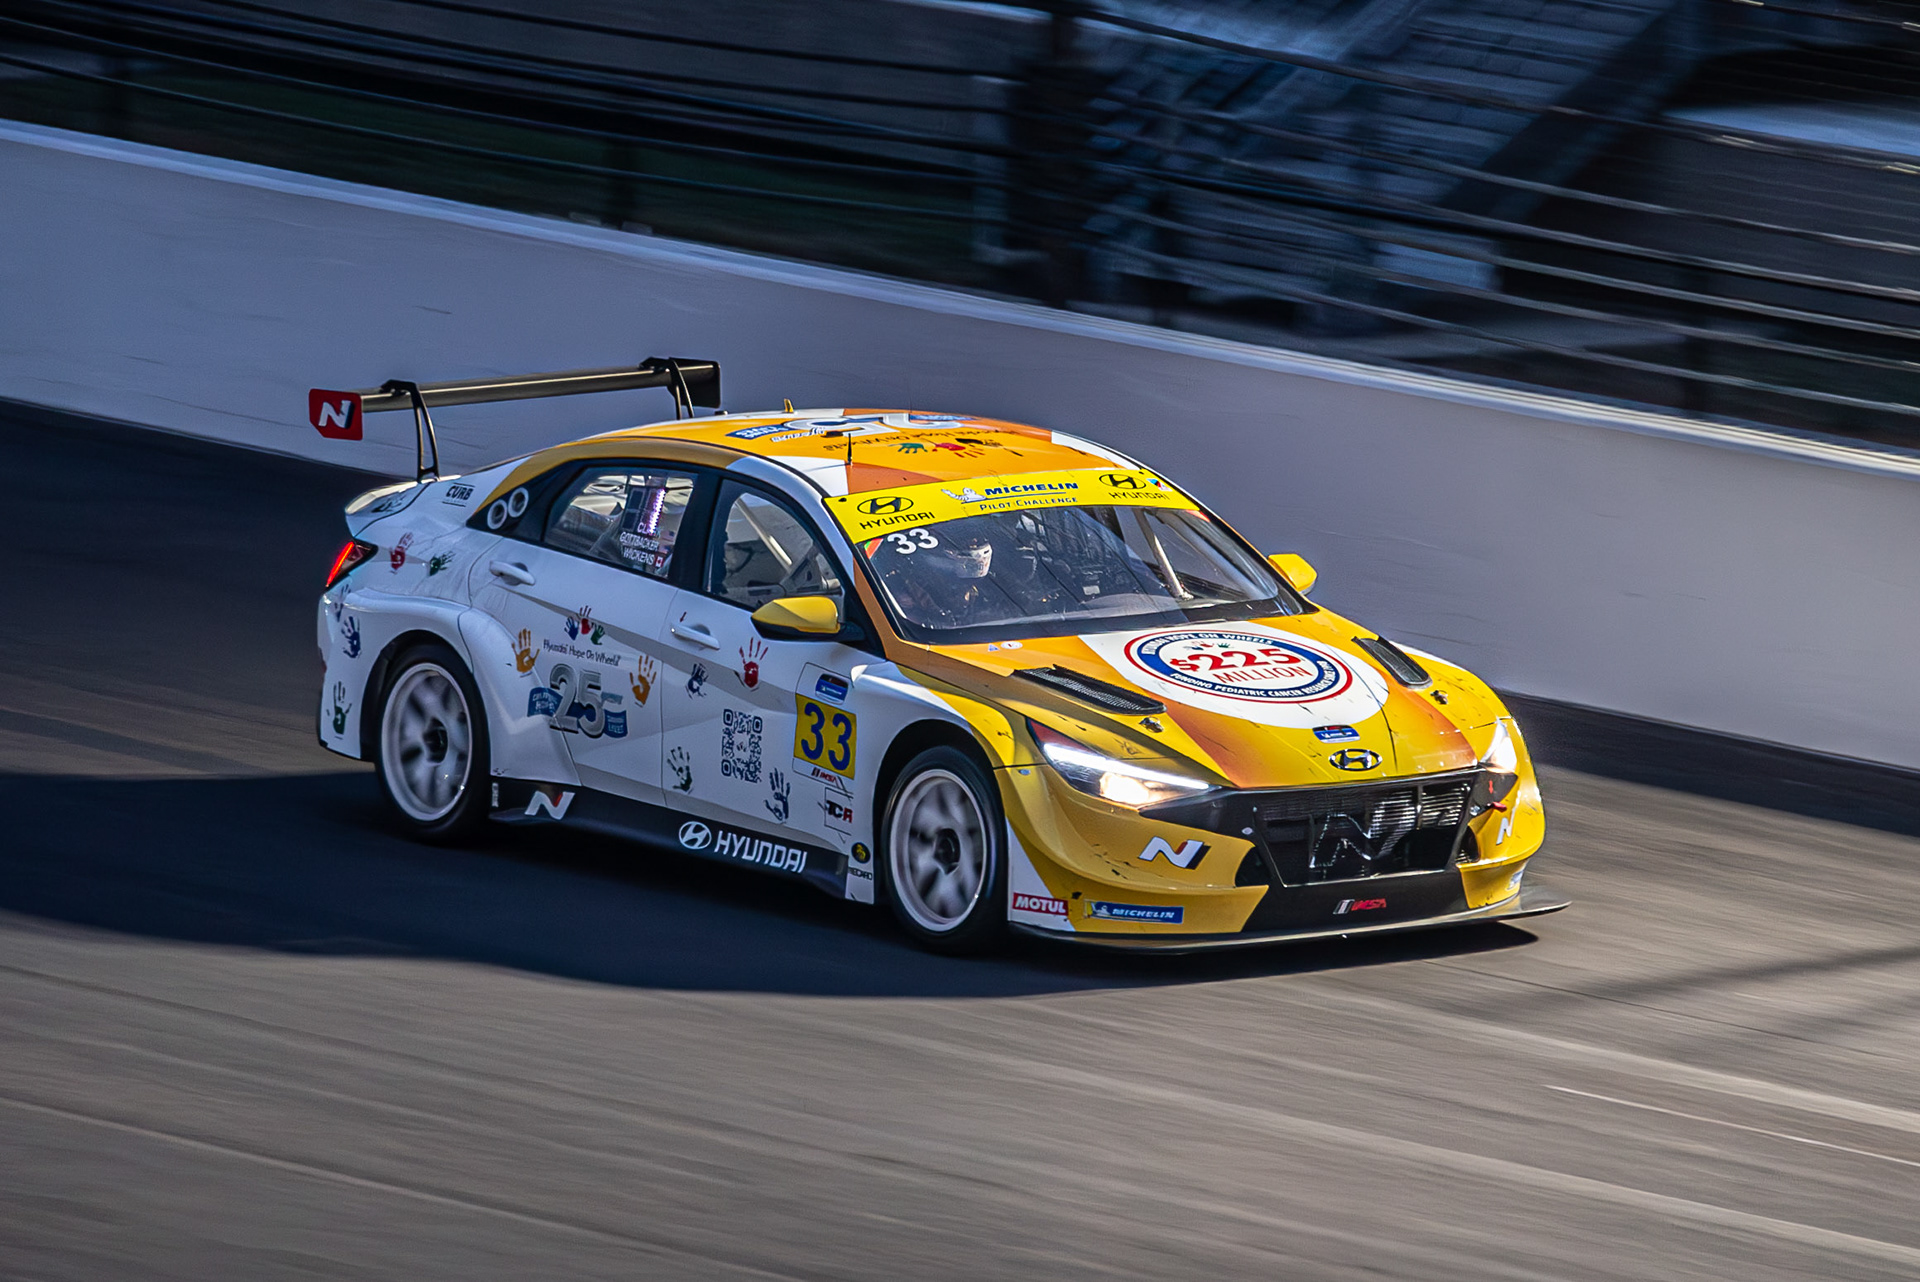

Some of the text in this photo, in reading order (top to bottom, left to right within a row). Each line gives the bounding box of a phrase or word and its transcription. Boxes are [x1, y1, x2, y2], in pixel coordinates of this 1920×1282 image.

[318, 399, 355, 429] N
[445, 484, 475, 501] CURB
[984, 482, 1079, 496] MICHELIN
[1108, 490, 1169, 501] HYUNDAI
[980, 496, 1079, 511] PILOT CHALLENGE
[859, 511, 935, 531] HYUNDAI
[886, 528, 939, 555] 33
[623, 546, 655, 566] WICKENS
[1222, 633, 1274, 646] WHEELS
[569, 644, 585, 659] Hope
[586, 649, 595, 660] On
[1169, 648, 1301, 672] $225
[1169, 672, 1213, 689] FUNDING
[1214, 684, 1267, 697] PEDIATRIC
[1267, 689, 1306, 698] CANCER
[1212, 666, 1314, 684] MILLION
[549, 662, 606, 739] 25
[800, 701, 852, 771] 33
[524, 790, 576, 820] N
[825, 799, 853, 824] TCR
[713, 830, 808, 874] HYUNDAI
[1137, 836, 1209, 870] N
[1014, 895, 1067, 914] MOTUL
[1111, 907, 1175, 920] MICHELIN
